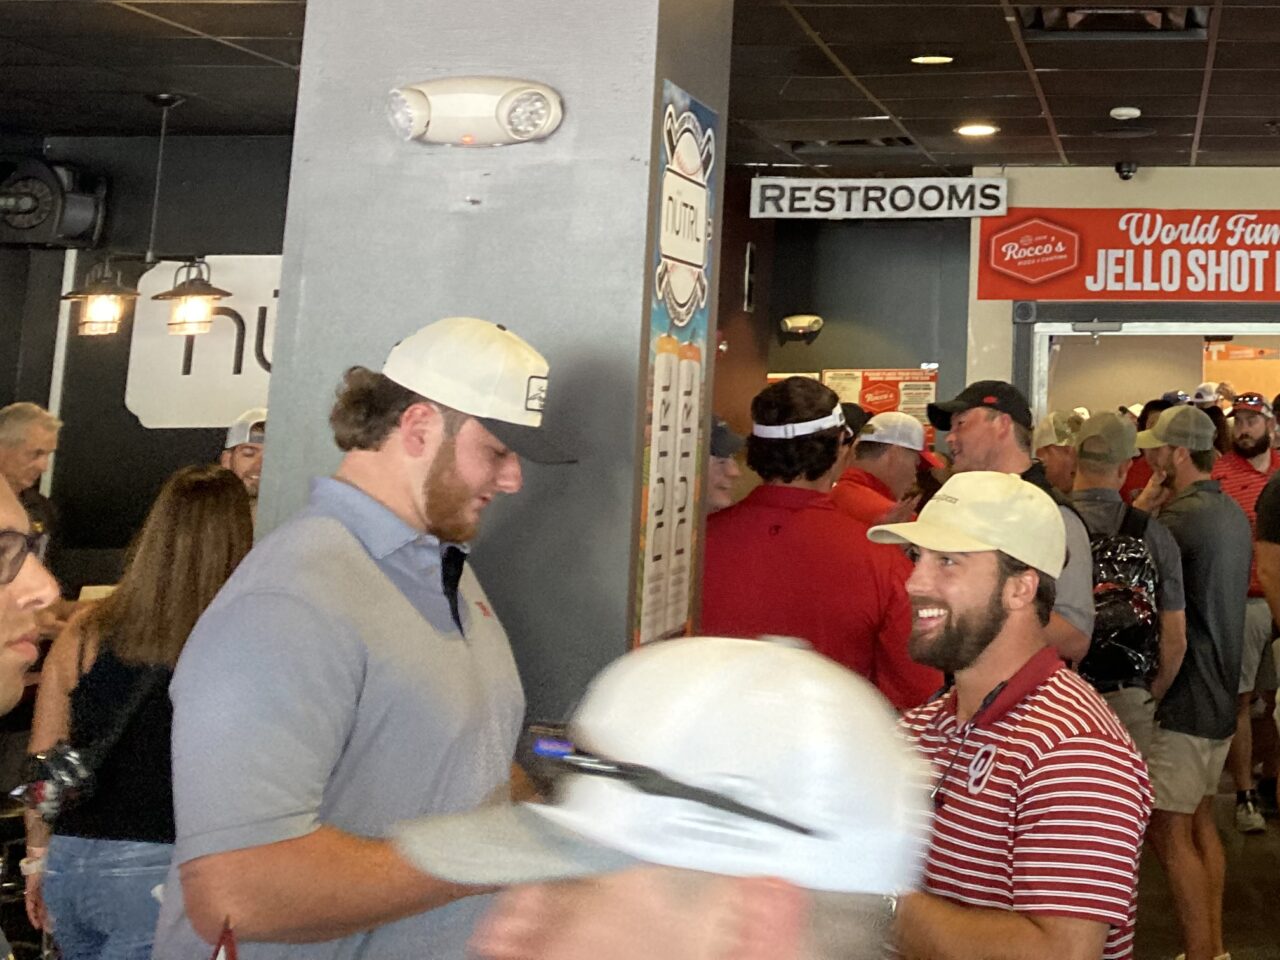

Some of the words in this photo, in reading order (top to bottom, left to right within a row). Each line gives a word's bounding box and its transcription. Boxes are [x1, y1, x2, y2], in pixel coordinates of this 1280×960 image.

[758, 183, 1001, 214] RESTROOMS
[1118, 212, 1221, 246] World
[1000, 236, 1067, 261] Rocco's
[1085, 249, 1182, 292] JELLO
[1186, 249, 1270, 293] SHOT
